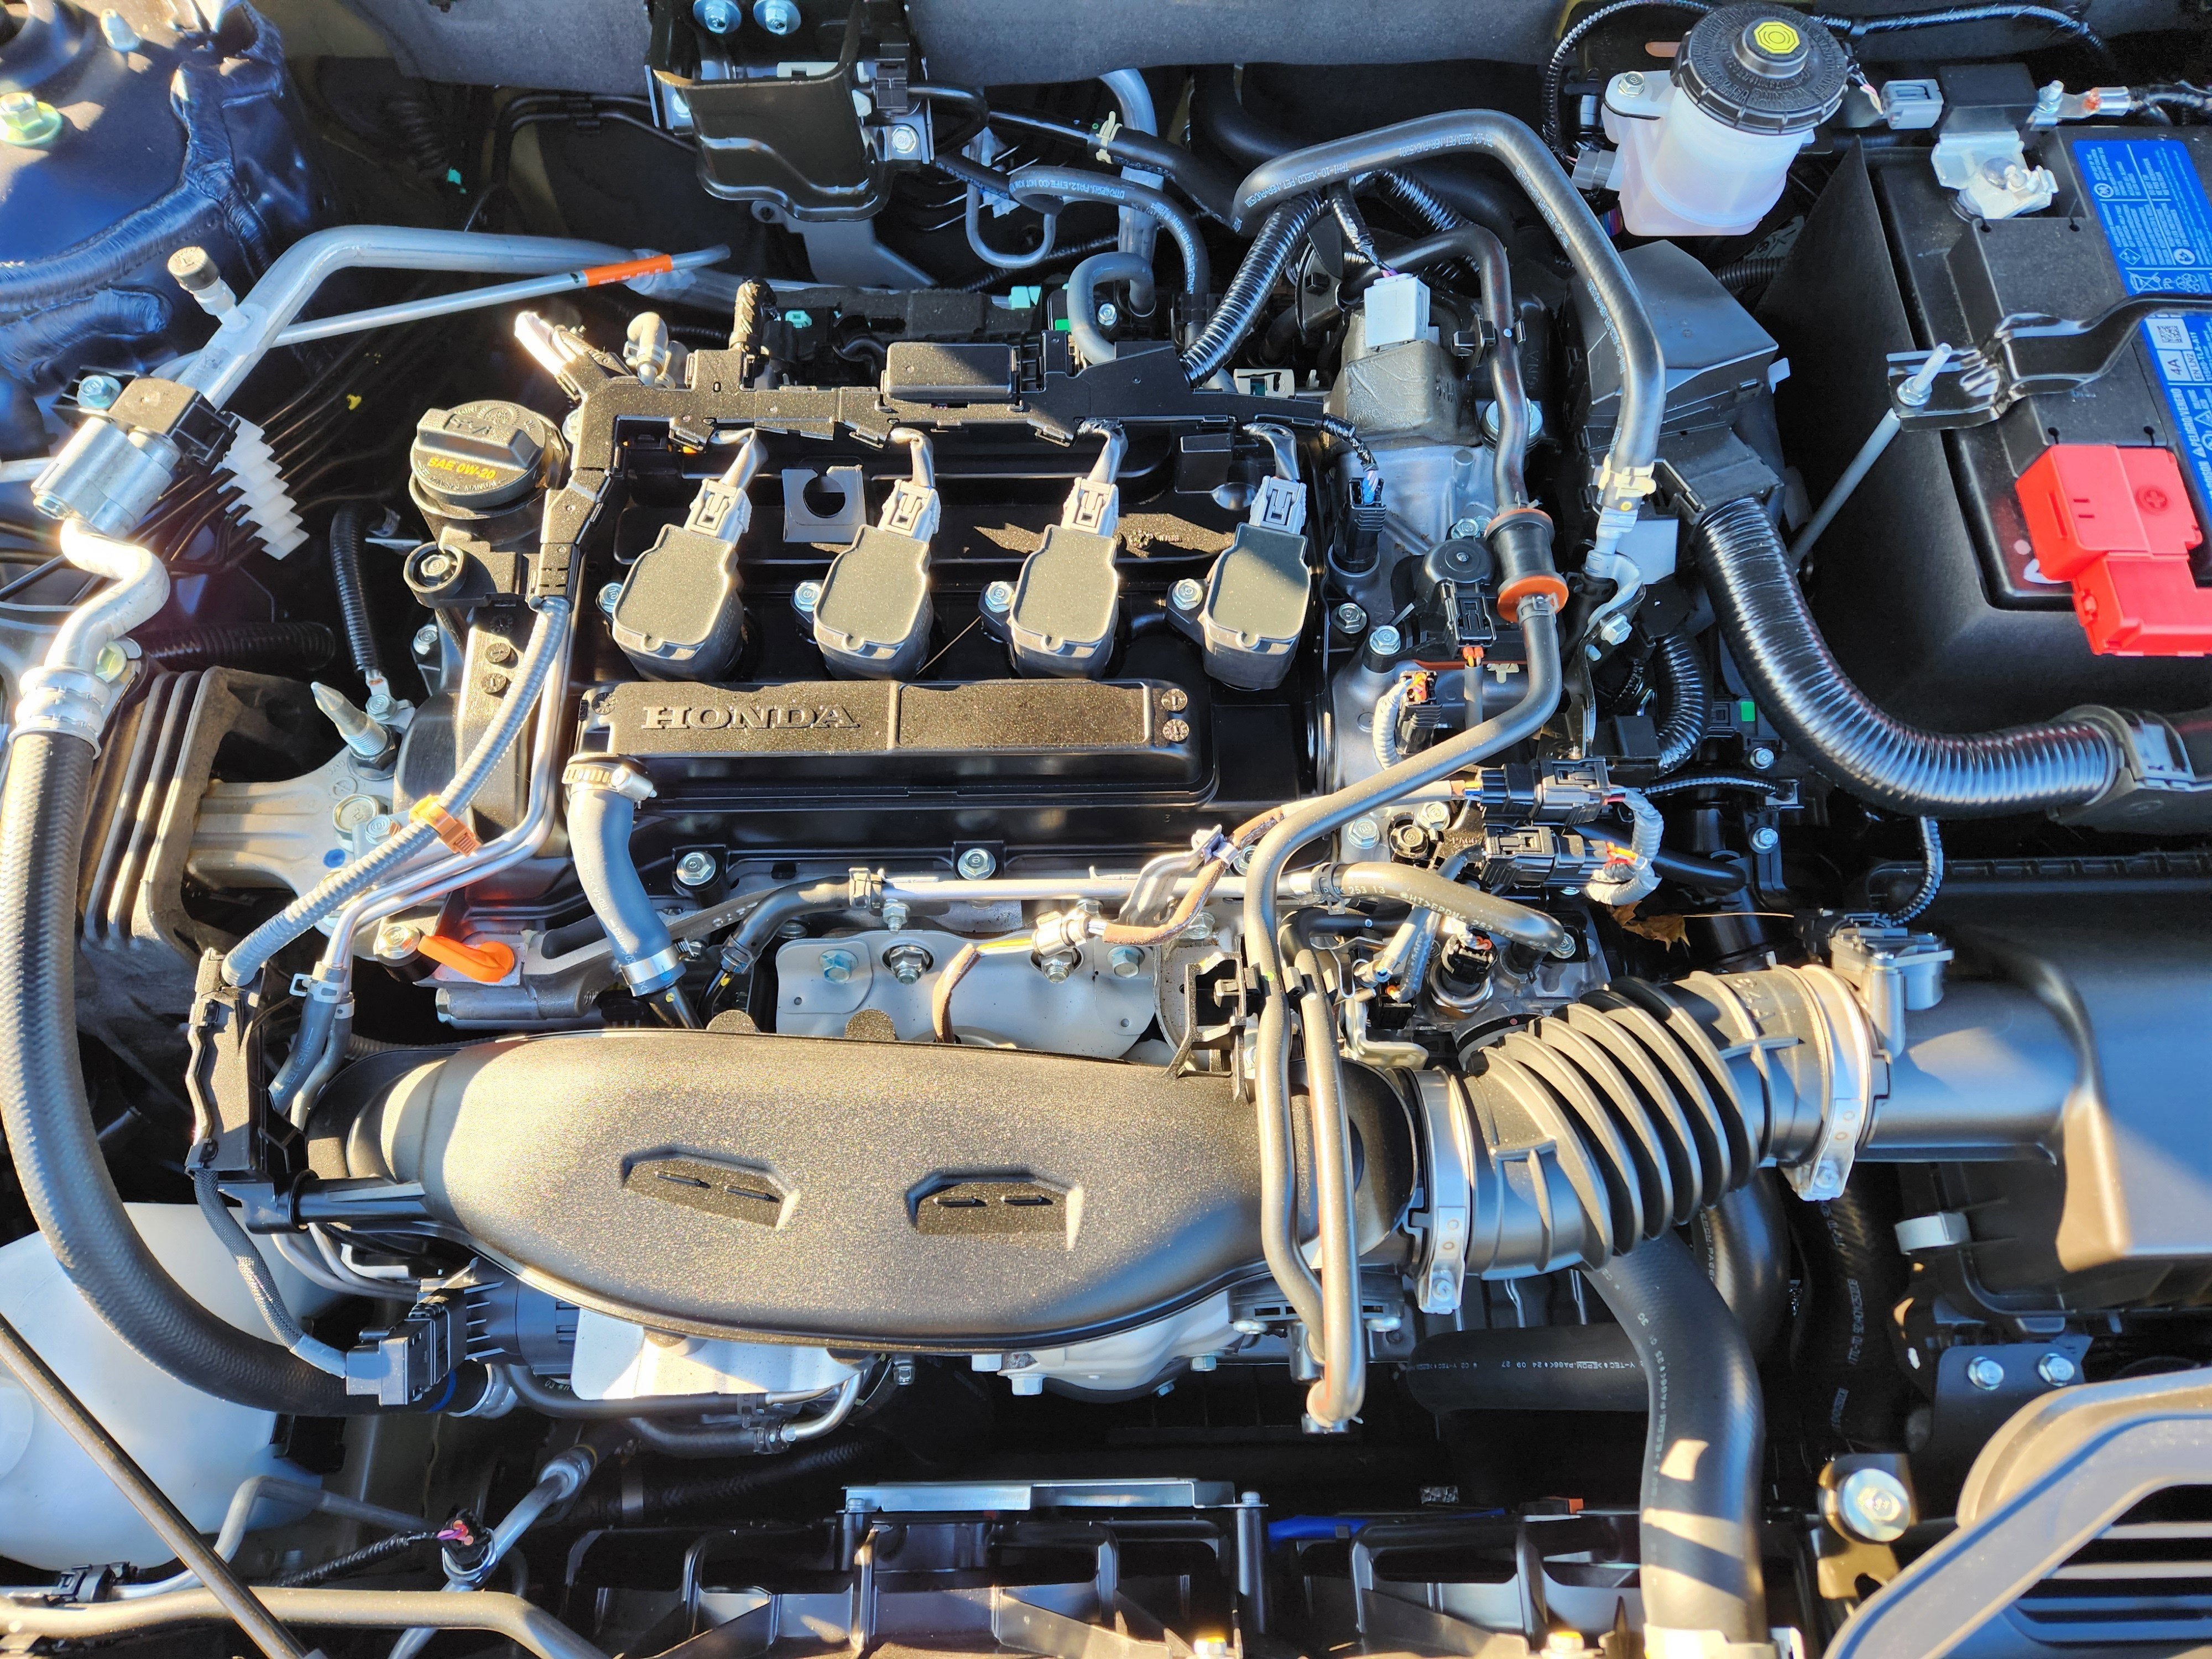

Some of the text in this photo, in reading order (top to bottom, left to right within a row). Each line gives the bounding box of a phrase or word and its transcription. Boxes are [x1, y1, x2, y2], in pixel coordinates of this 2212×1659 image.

[2167, 359, 2182, 375] 4A
[2187, 353, 2201, 379] EN LN2
[427, 457, 497, 480] SAE 0W-20
[641, 706, 862, 729] HONDA
[1348, 886, 1368, 895] 253
[1372, 885, 1386, 894] 13
